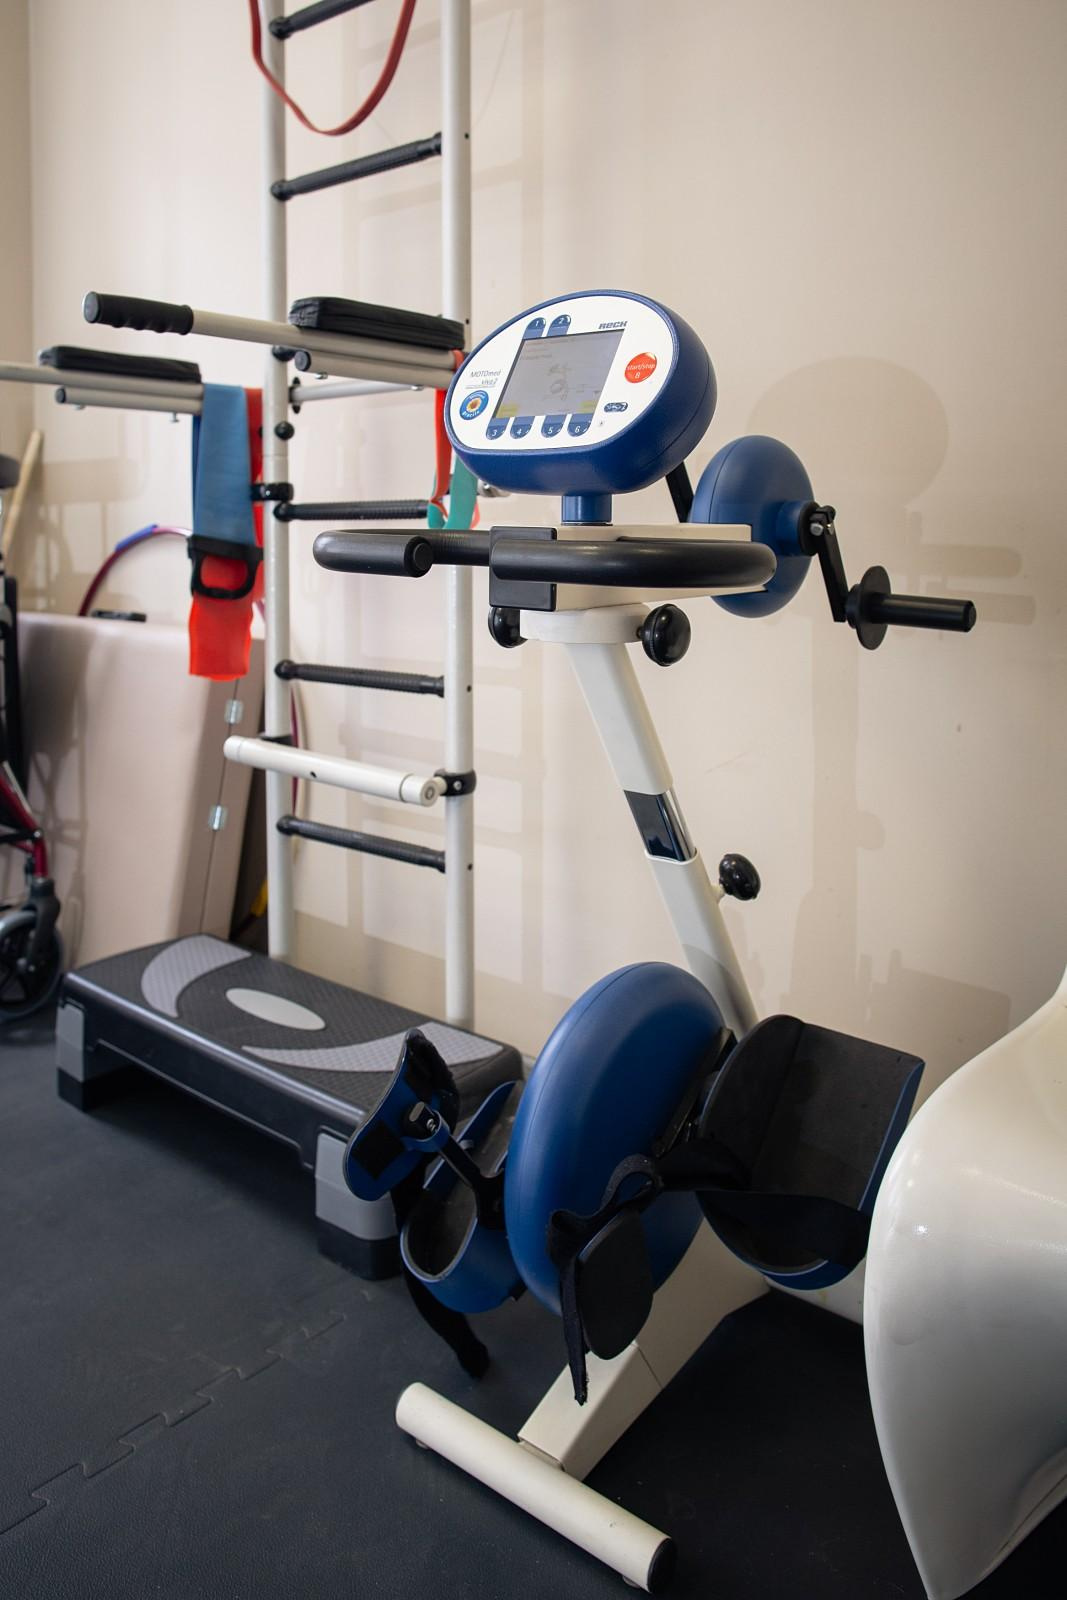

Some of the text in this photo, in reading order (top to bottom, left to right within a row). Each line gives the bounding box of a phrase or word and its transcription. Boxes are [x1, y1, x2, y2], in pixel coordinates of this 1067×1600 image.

[491, 429, 498, 437] 3
[547, 426, 554, 434] 5
[574, 425, 581, 433] 6
